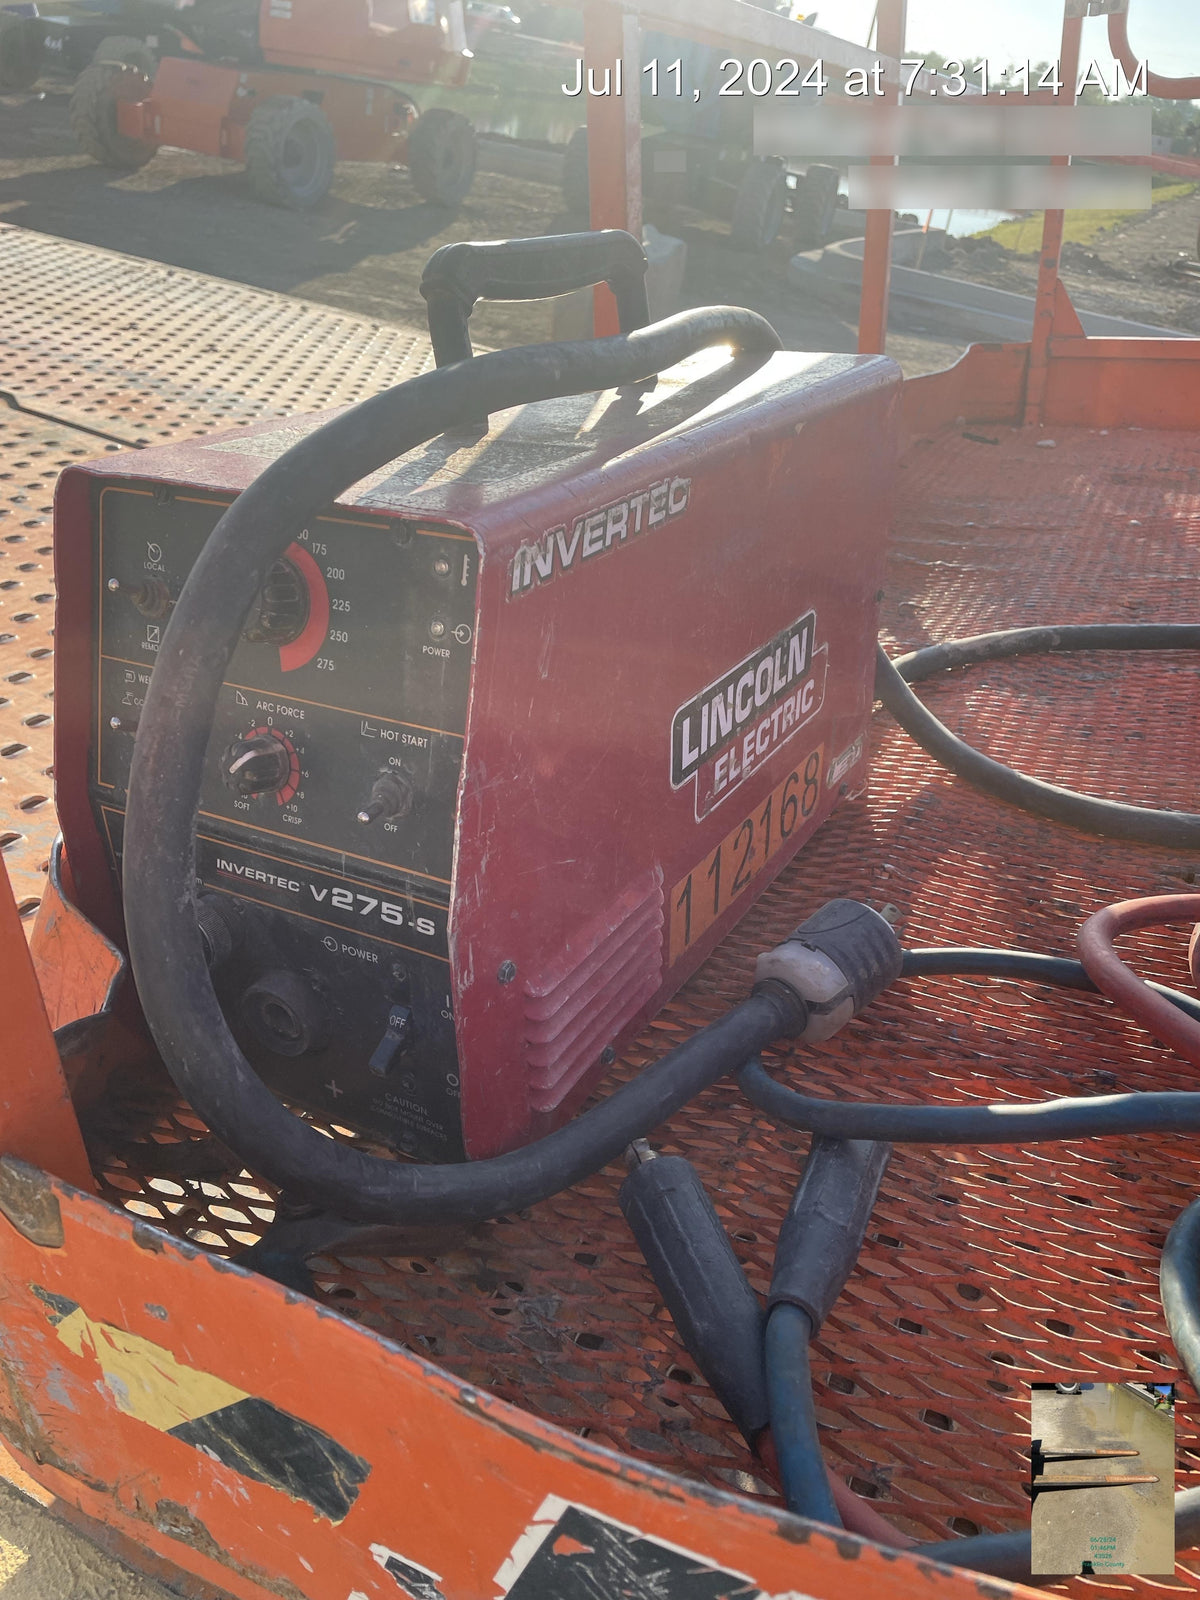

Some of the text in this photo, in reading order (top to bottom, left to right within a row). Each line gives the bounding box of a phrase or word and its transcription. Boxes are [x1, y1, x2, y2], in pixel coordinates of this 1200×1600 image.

[511, 476, 689, 593] INVERTEC
[312, 542, 328, 556] 175
[143, 562, 166, 573] LOCAL
[326, 566, 345, 580] 200
[332, 598, 351, 612] 225
[329, 629, 349, 643] 250
[141, 641, 161, 651] REMO
[422, 645, 451, 658] POWER
[316, 657, 335, 671] 275
[681, 626, 809, 771] LINCOLN
[256, 700, 305, 720] ARC FORCE
[248, 719, 256, 728] -2
[267, 716, 273, 726] 0
[285, 730, 294, 739] +2
[380, 728, 428, 748] HOT START
[713, 678, 815, 797] ELECTRIC
[295, 747, 305, 755] +4
[388, 756, 401, 767] ON
[301, 769, 310, 778] +6
[296, 790, 305, 799] +8
[233, 800, 250, 811] SOFT
[286, 804, 298, 813] +10
[282, 813, 302, 825] CRISP
[384, 823, 398, 833] OFF
[676, 752, 821, 947] 112168
[216, 858, 300, 893] INVERTEC
[342, 944, 378, 964] POWER
[389, 1014, 407, 1029] OFF
[446, 1087, 460, 1099] OF
[384, 1092, 429, 1117] CAUTION
